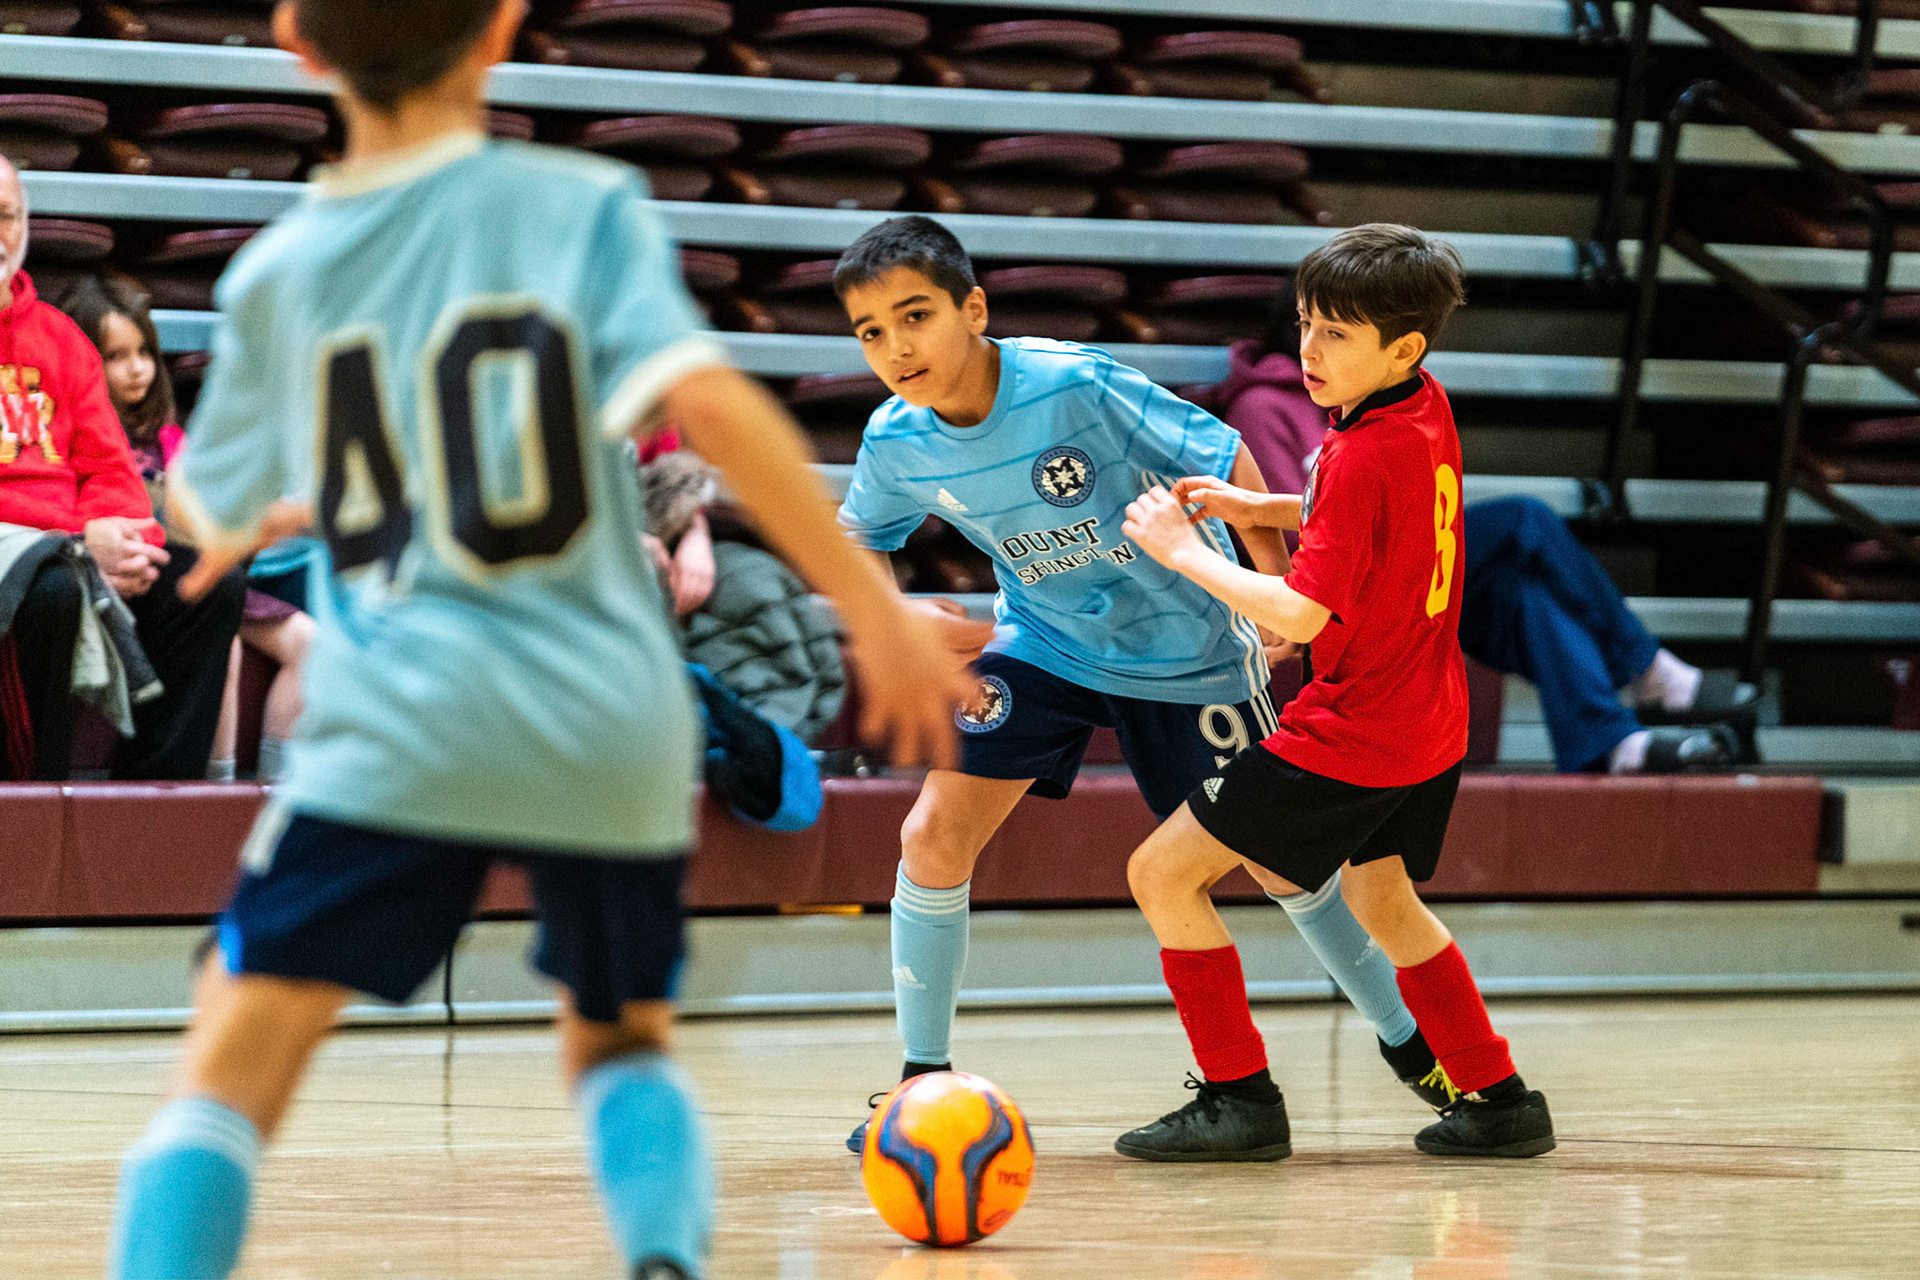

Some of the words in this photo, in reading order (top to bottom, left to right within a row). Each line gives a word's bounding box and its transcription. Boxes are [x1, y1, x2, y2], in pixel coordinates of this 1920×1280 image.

[316, 298, 591, 588] 40
[1000, 516, 1101, 561] OUNT
[1016, 541, 1136, 586] SHINGTN
[1199, 704, 1250, 770] 9
